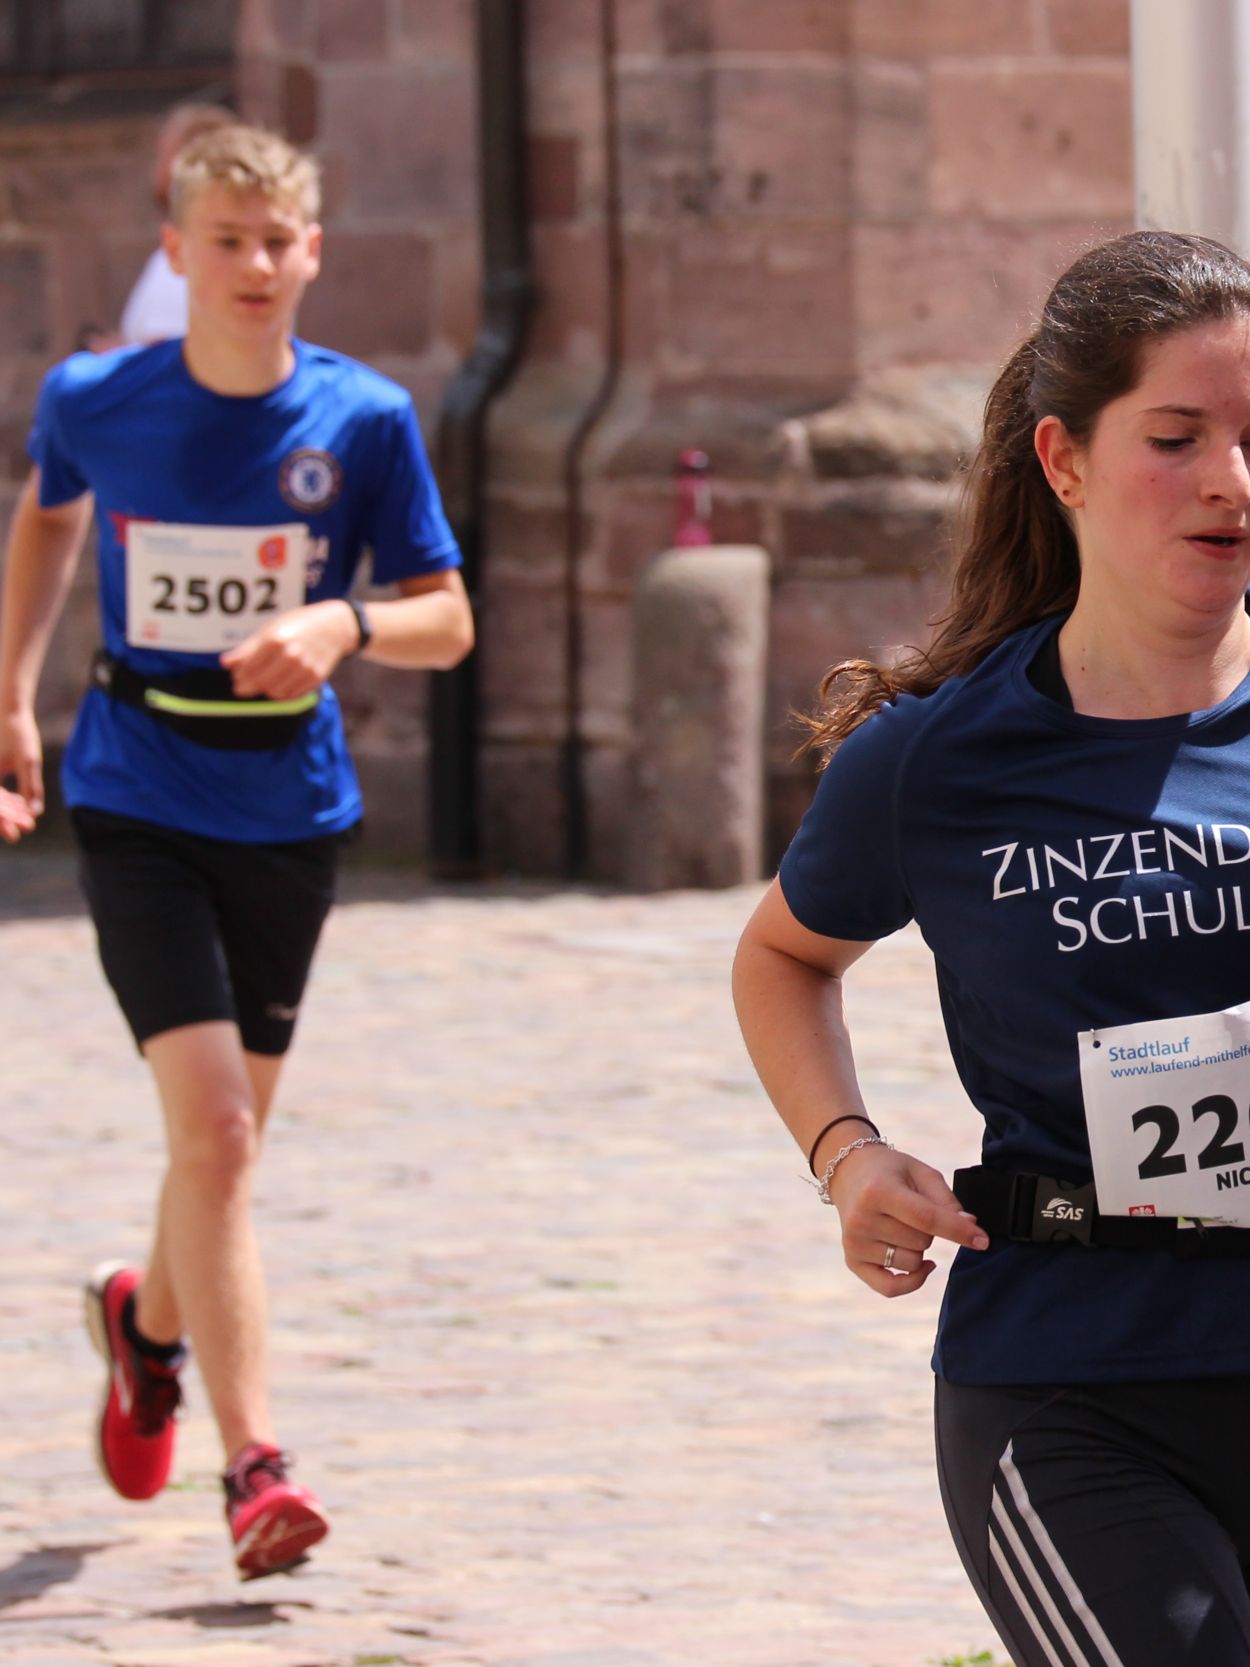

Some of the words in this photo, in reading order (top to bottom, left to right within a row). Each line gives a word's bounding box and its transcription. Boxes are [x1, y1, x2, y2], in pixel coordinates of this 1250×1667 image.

[152, 573, 278, 615] 2502
[1108, 1036, 1192, 1062] Stadtlauf
[1055, 1205, 1084, 1221] SAS
